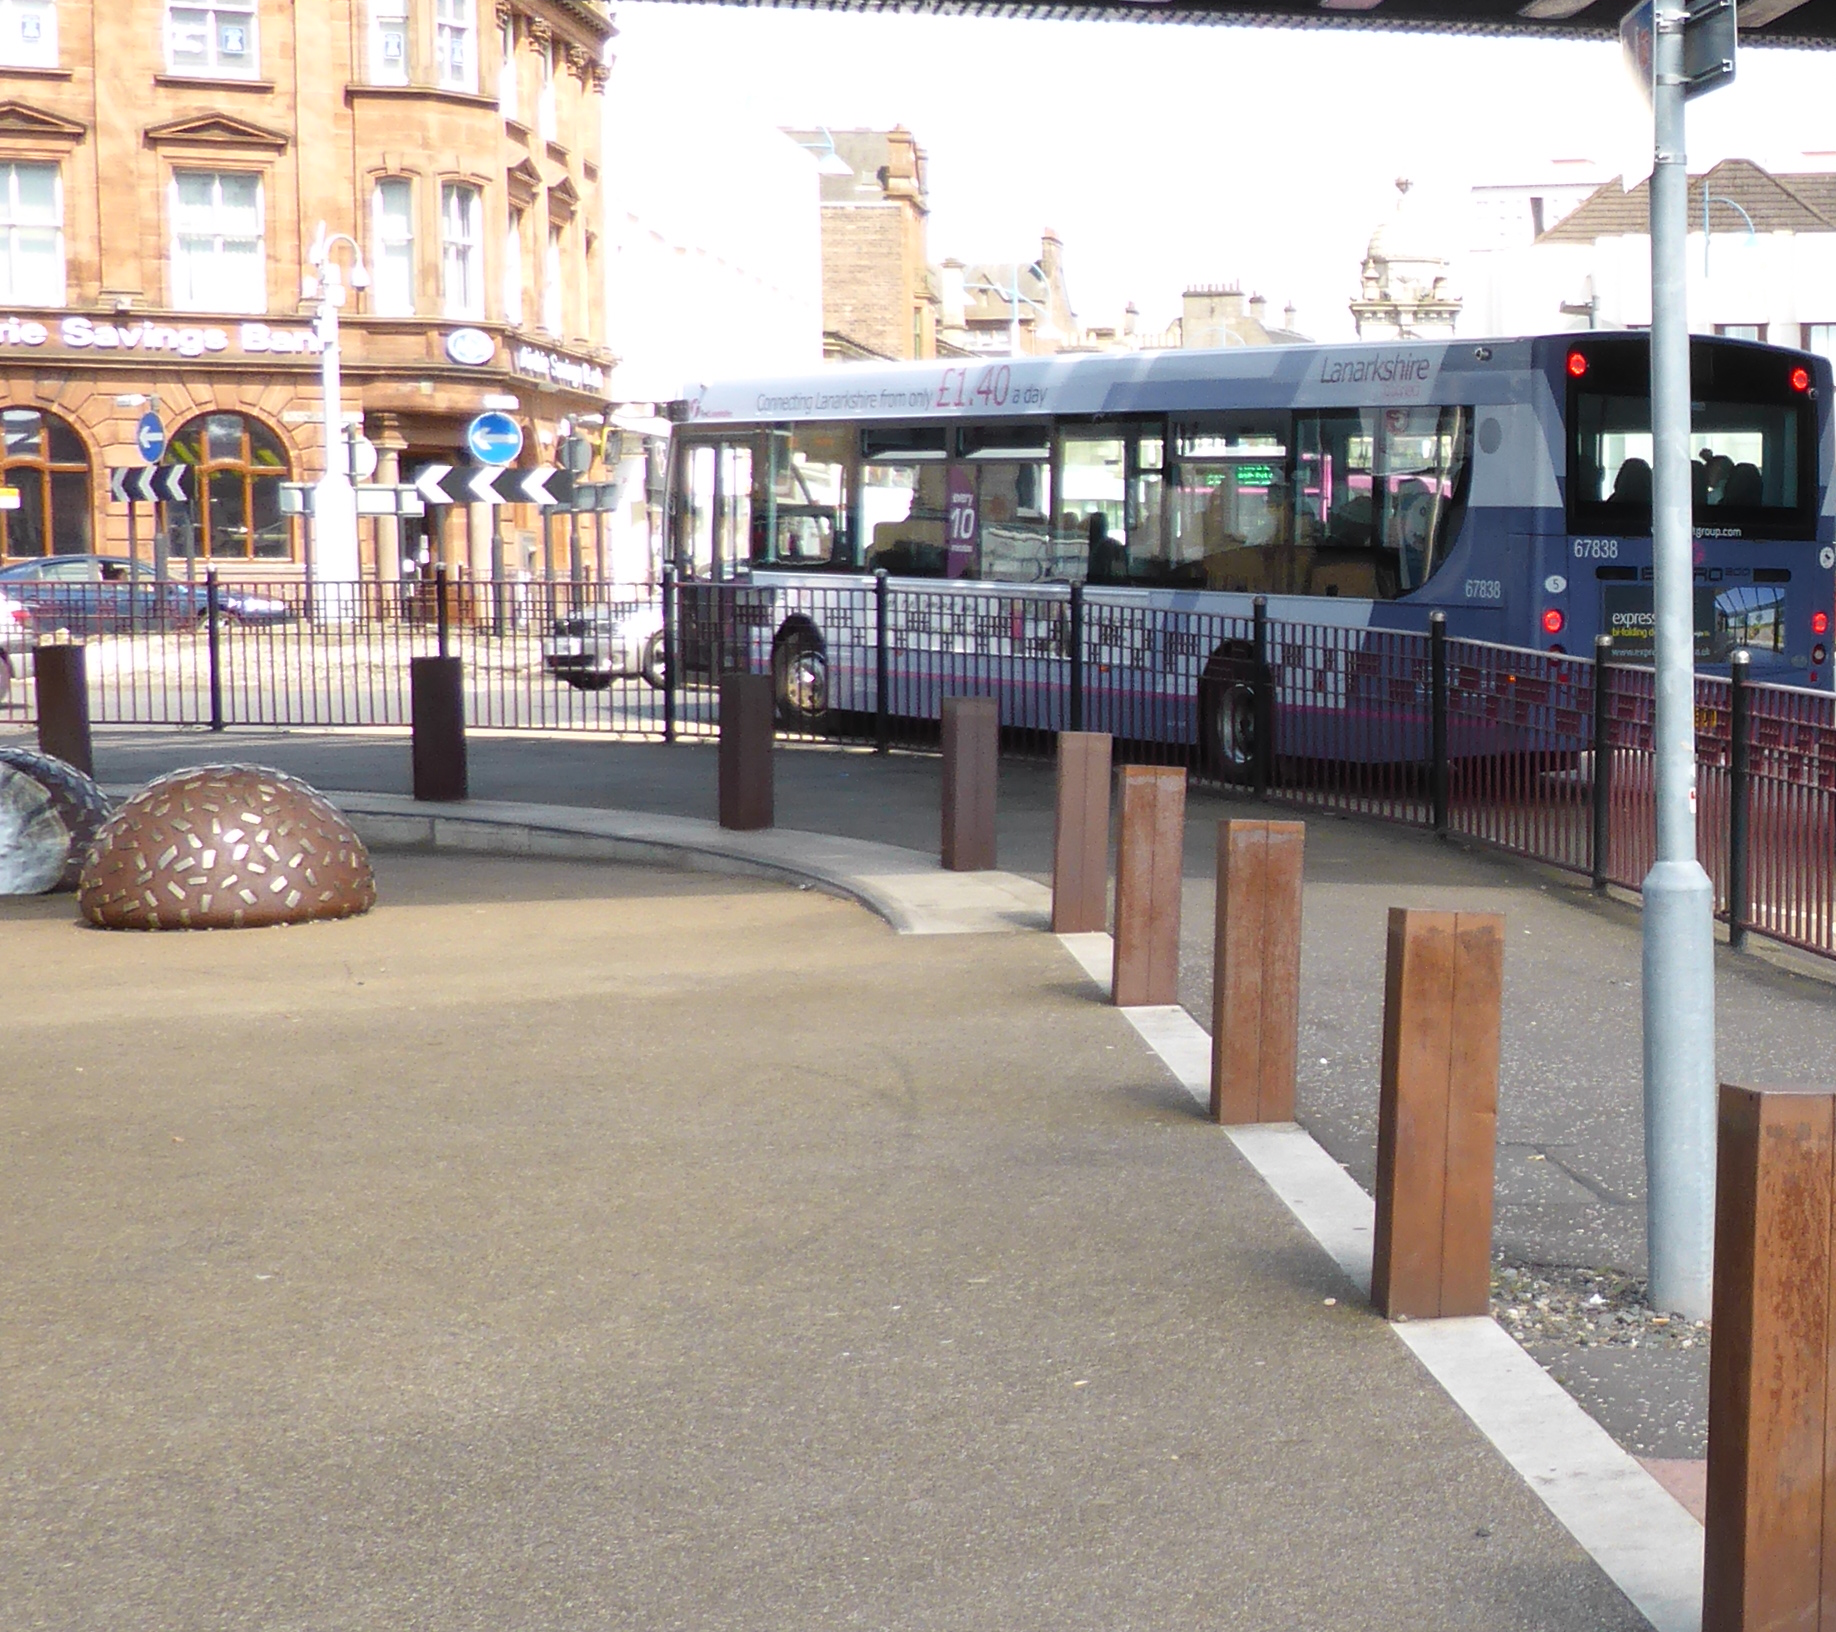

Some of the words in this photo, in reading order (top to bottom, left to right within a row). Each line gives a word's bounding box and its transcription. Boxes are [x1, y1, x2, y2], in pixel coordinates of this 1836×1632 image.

[61, 317, 228, 356] Savings
[240, 322, 341, 353] Ban
[1320, 352, 1430, 383] Lanarkshire
[936, 364, 1011, 408] £1.40
[1012, 389, 1021, 405] a
[1022, 383, 1049, 407] day
[950, 508, 975, 539] 10
[1574, 539, 1618, 559] 67838
[1465, 579, 1501, 599] 67838
[1552, 578, 1560, 591] 5
